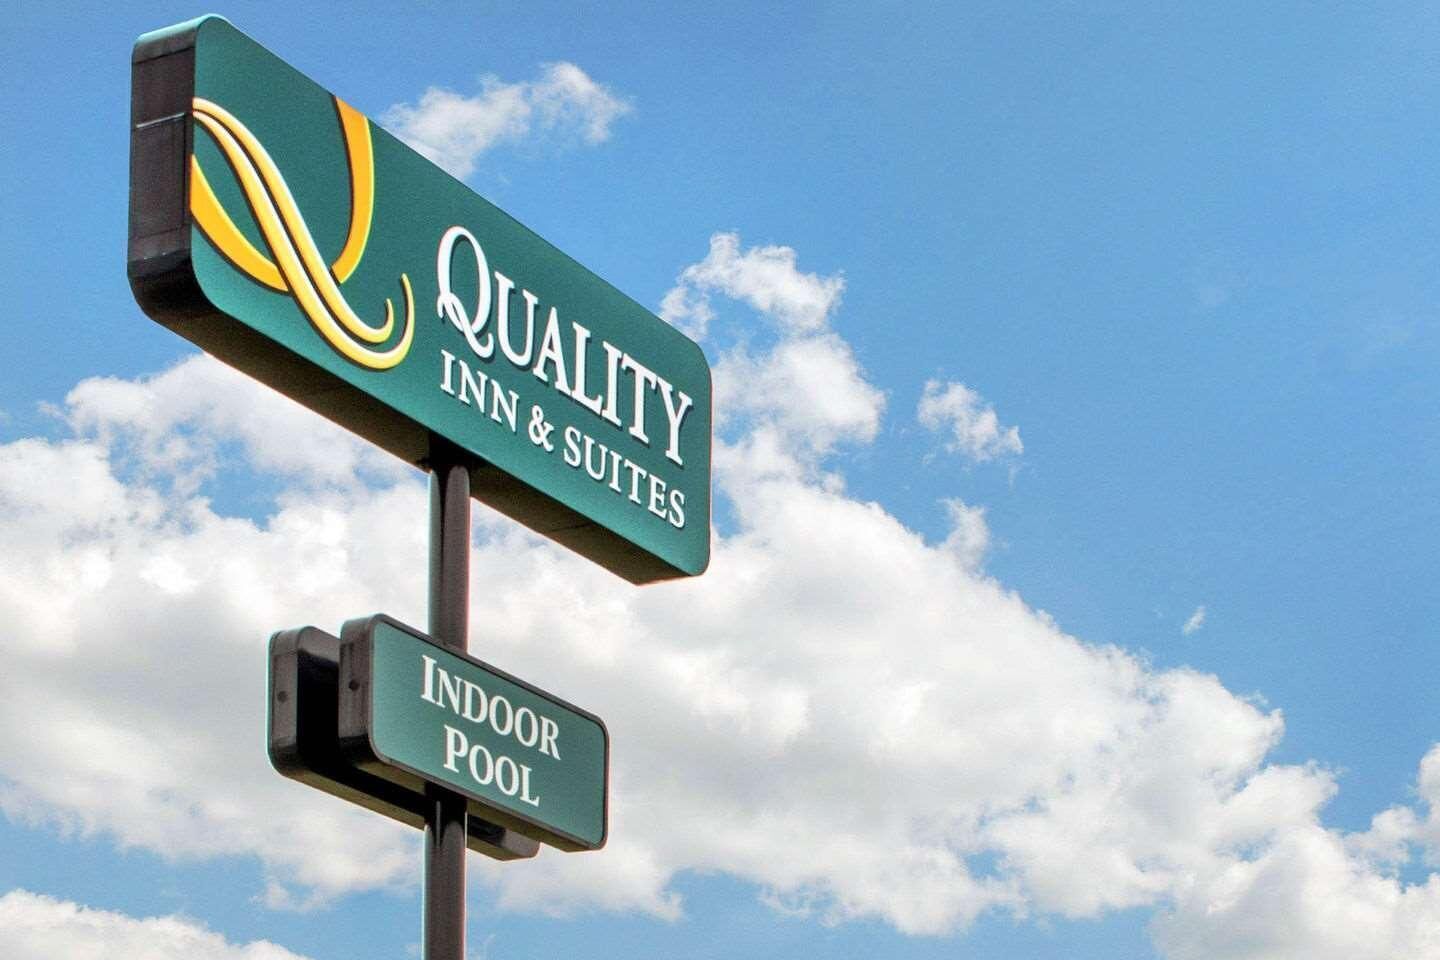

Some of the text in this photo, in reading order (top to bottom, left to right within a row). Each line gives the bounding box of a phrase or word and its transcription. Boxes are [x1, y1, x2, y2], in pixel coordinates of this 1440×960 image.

[437, 225, 693, 466] QUALITY
[440, 349, 686, 529] INN & SUITES
[420, 654, 562, 761] INDOOR
[443, 724, 541, 807] POOL
